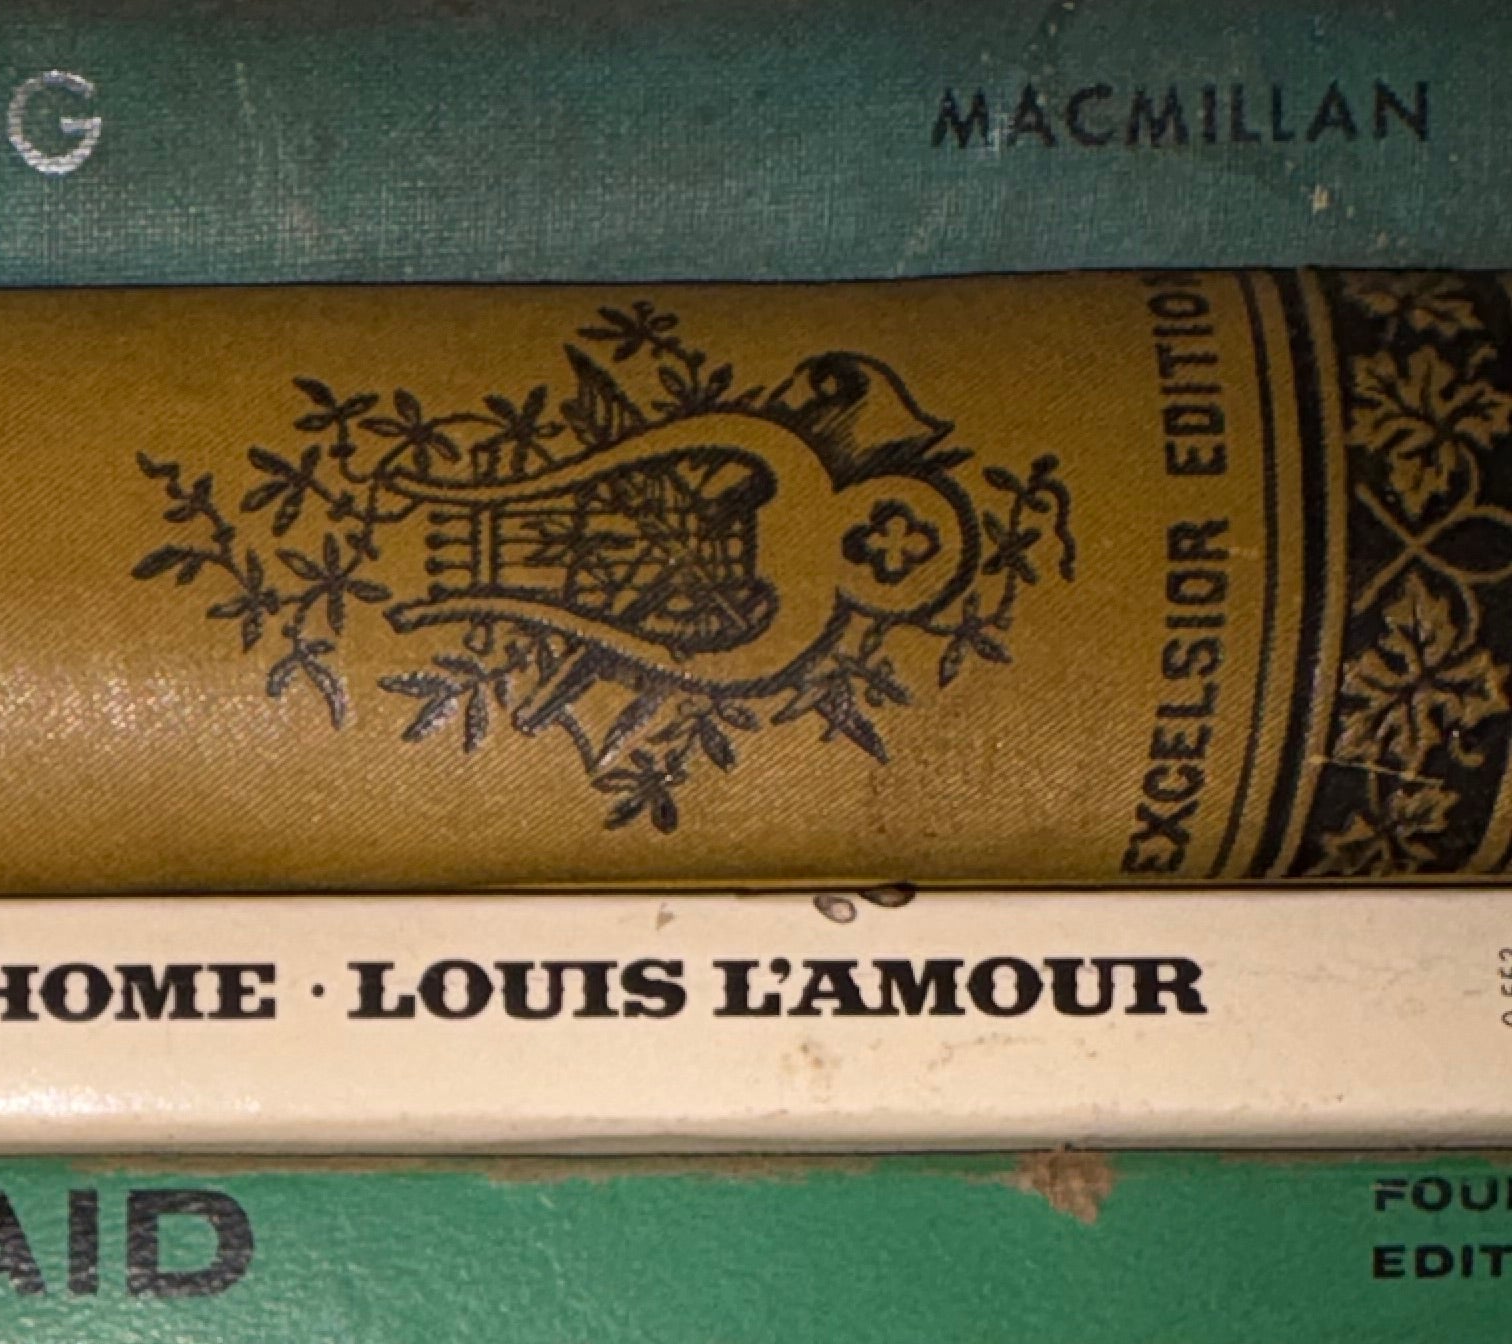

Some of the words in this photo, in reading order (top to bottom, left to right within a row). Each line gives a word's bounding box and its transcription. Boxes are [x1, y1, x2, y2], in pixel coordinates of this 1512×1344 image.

[930, 79, 1432, 150] MACMILLAN
[1120, 517, 1230, 877] EXCELSIOR
[347, 957, 689, 1020] LOUIS
[712, 956, 1208, 1018] L'AMOUR
[1372, 1176, 1512, 1213] FOU
